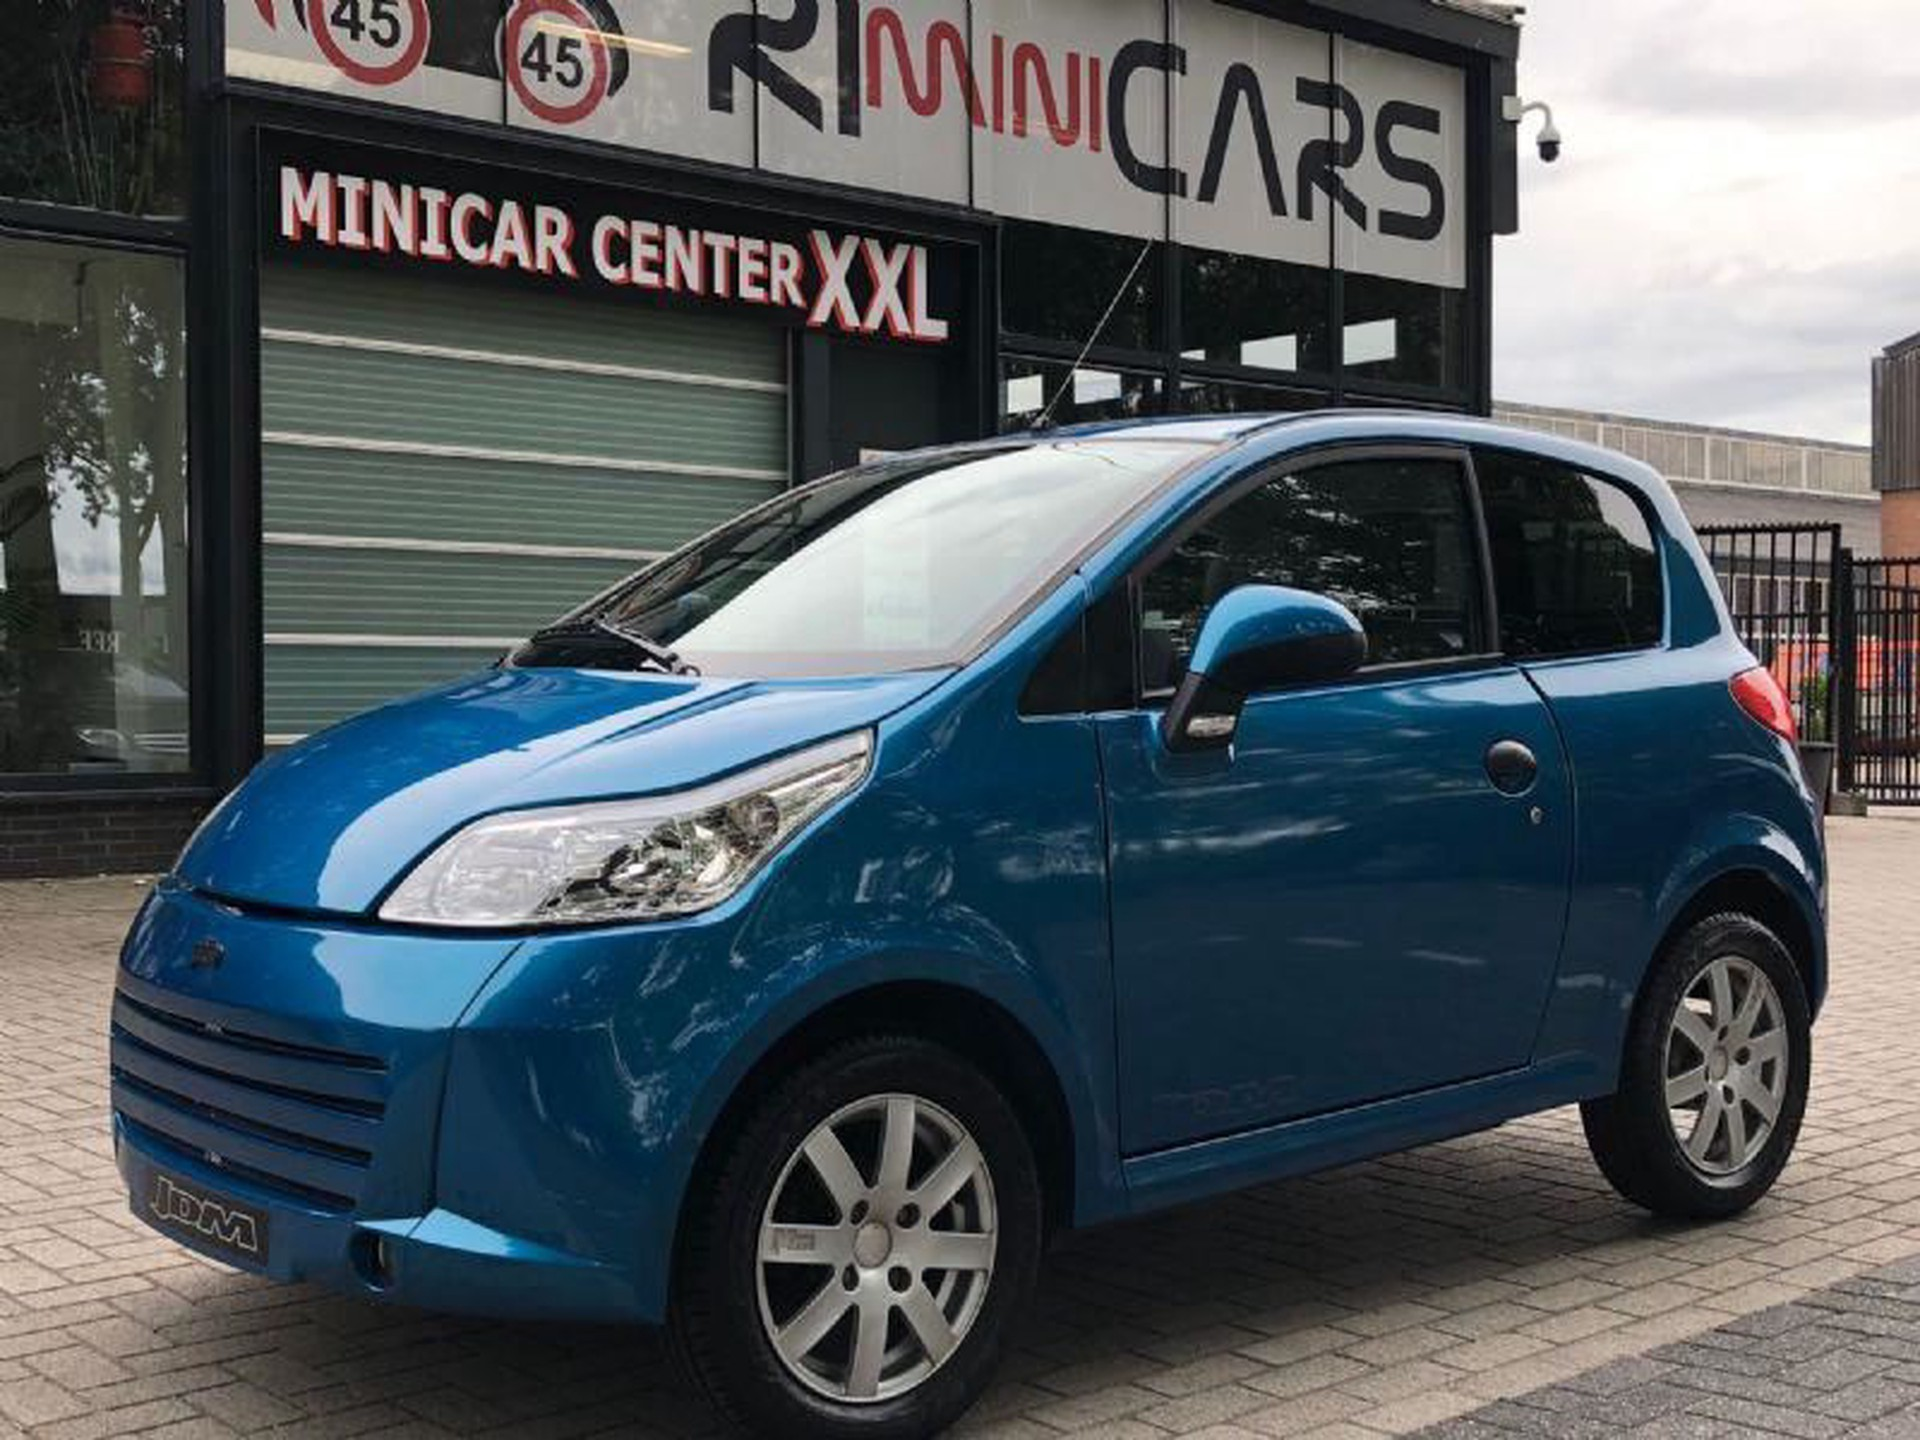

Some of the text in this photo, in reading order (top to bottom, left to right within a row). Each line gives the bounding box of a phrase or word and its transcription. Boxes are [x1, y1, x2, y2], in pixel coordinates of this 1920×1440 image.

[330, 0, 401, 48] 45
[520, 31, 584, 88] 45
[280, 166, 949, 341] MINICAR CENTER XXL
[151, 1175, 258, 1252] JDM
